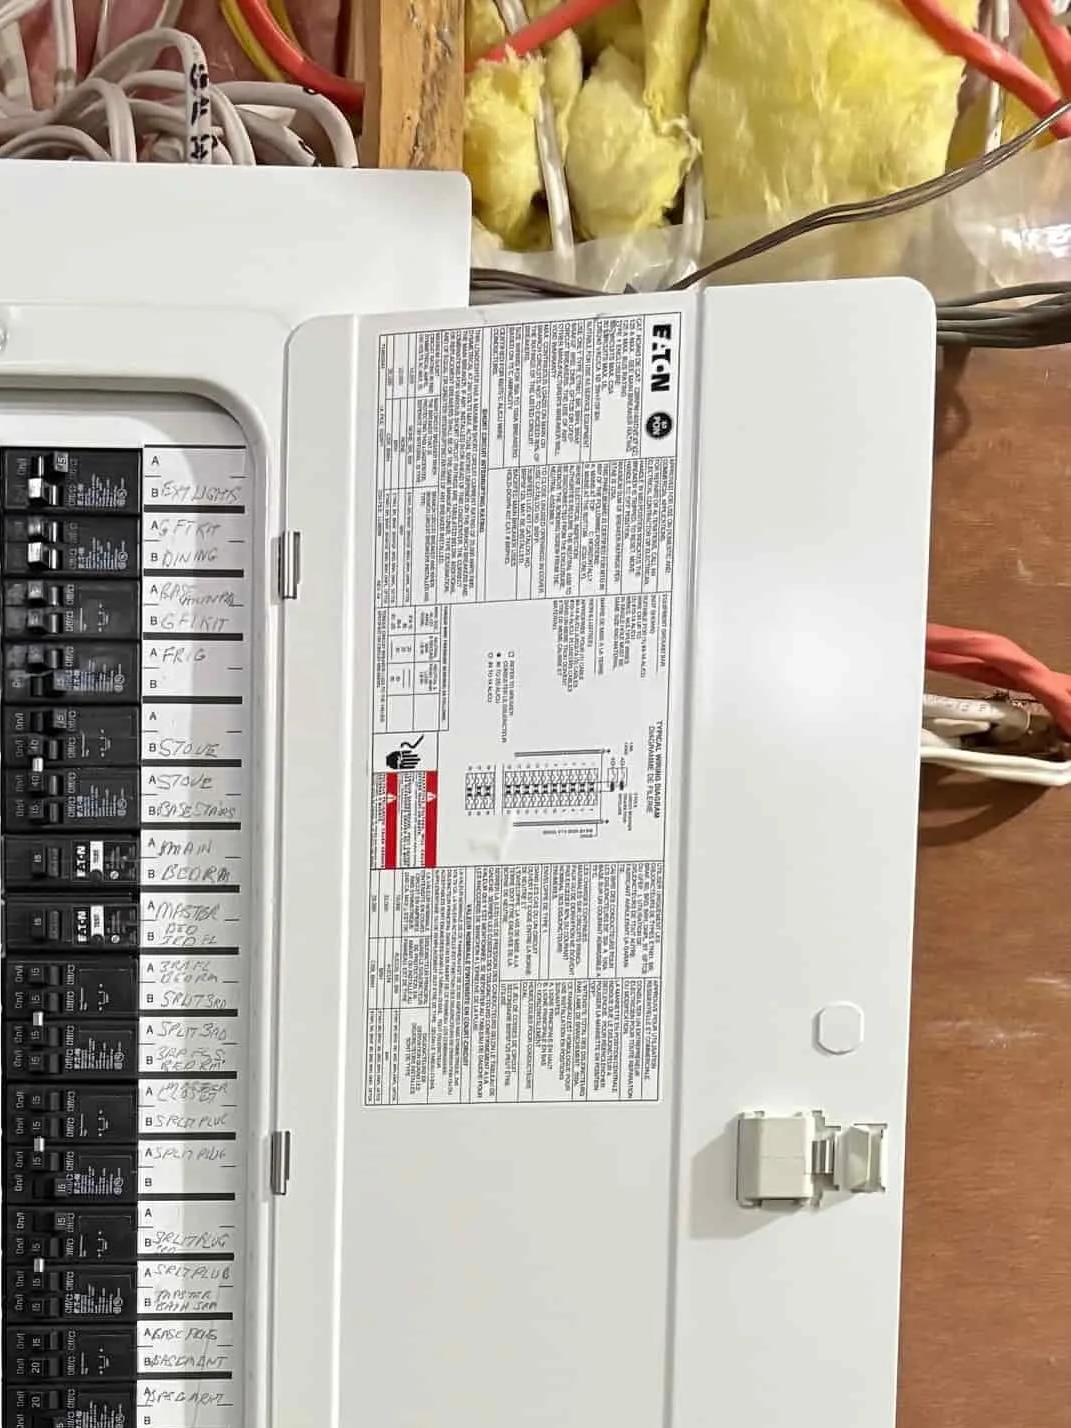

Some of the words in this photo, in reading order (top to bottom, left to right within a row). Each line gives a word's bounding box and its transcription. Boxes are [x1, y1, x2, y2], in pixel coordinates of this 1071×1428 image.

[151, 456, 159, 465] A
[152, 488, 159, 497] B
[162, 547, 218, 567] DINING
[149, 711, 157, 720] A
[149, 743, 156, 752] B
[159, 738, 220, 758] STOVE
[157, 772, 213, 790] STOVE
[147, 963, 154, 972] A
[147, 994, 153, 1003] B
[145, 1268, 151, 1277] A
[145, 1298, 151, 1306] B
